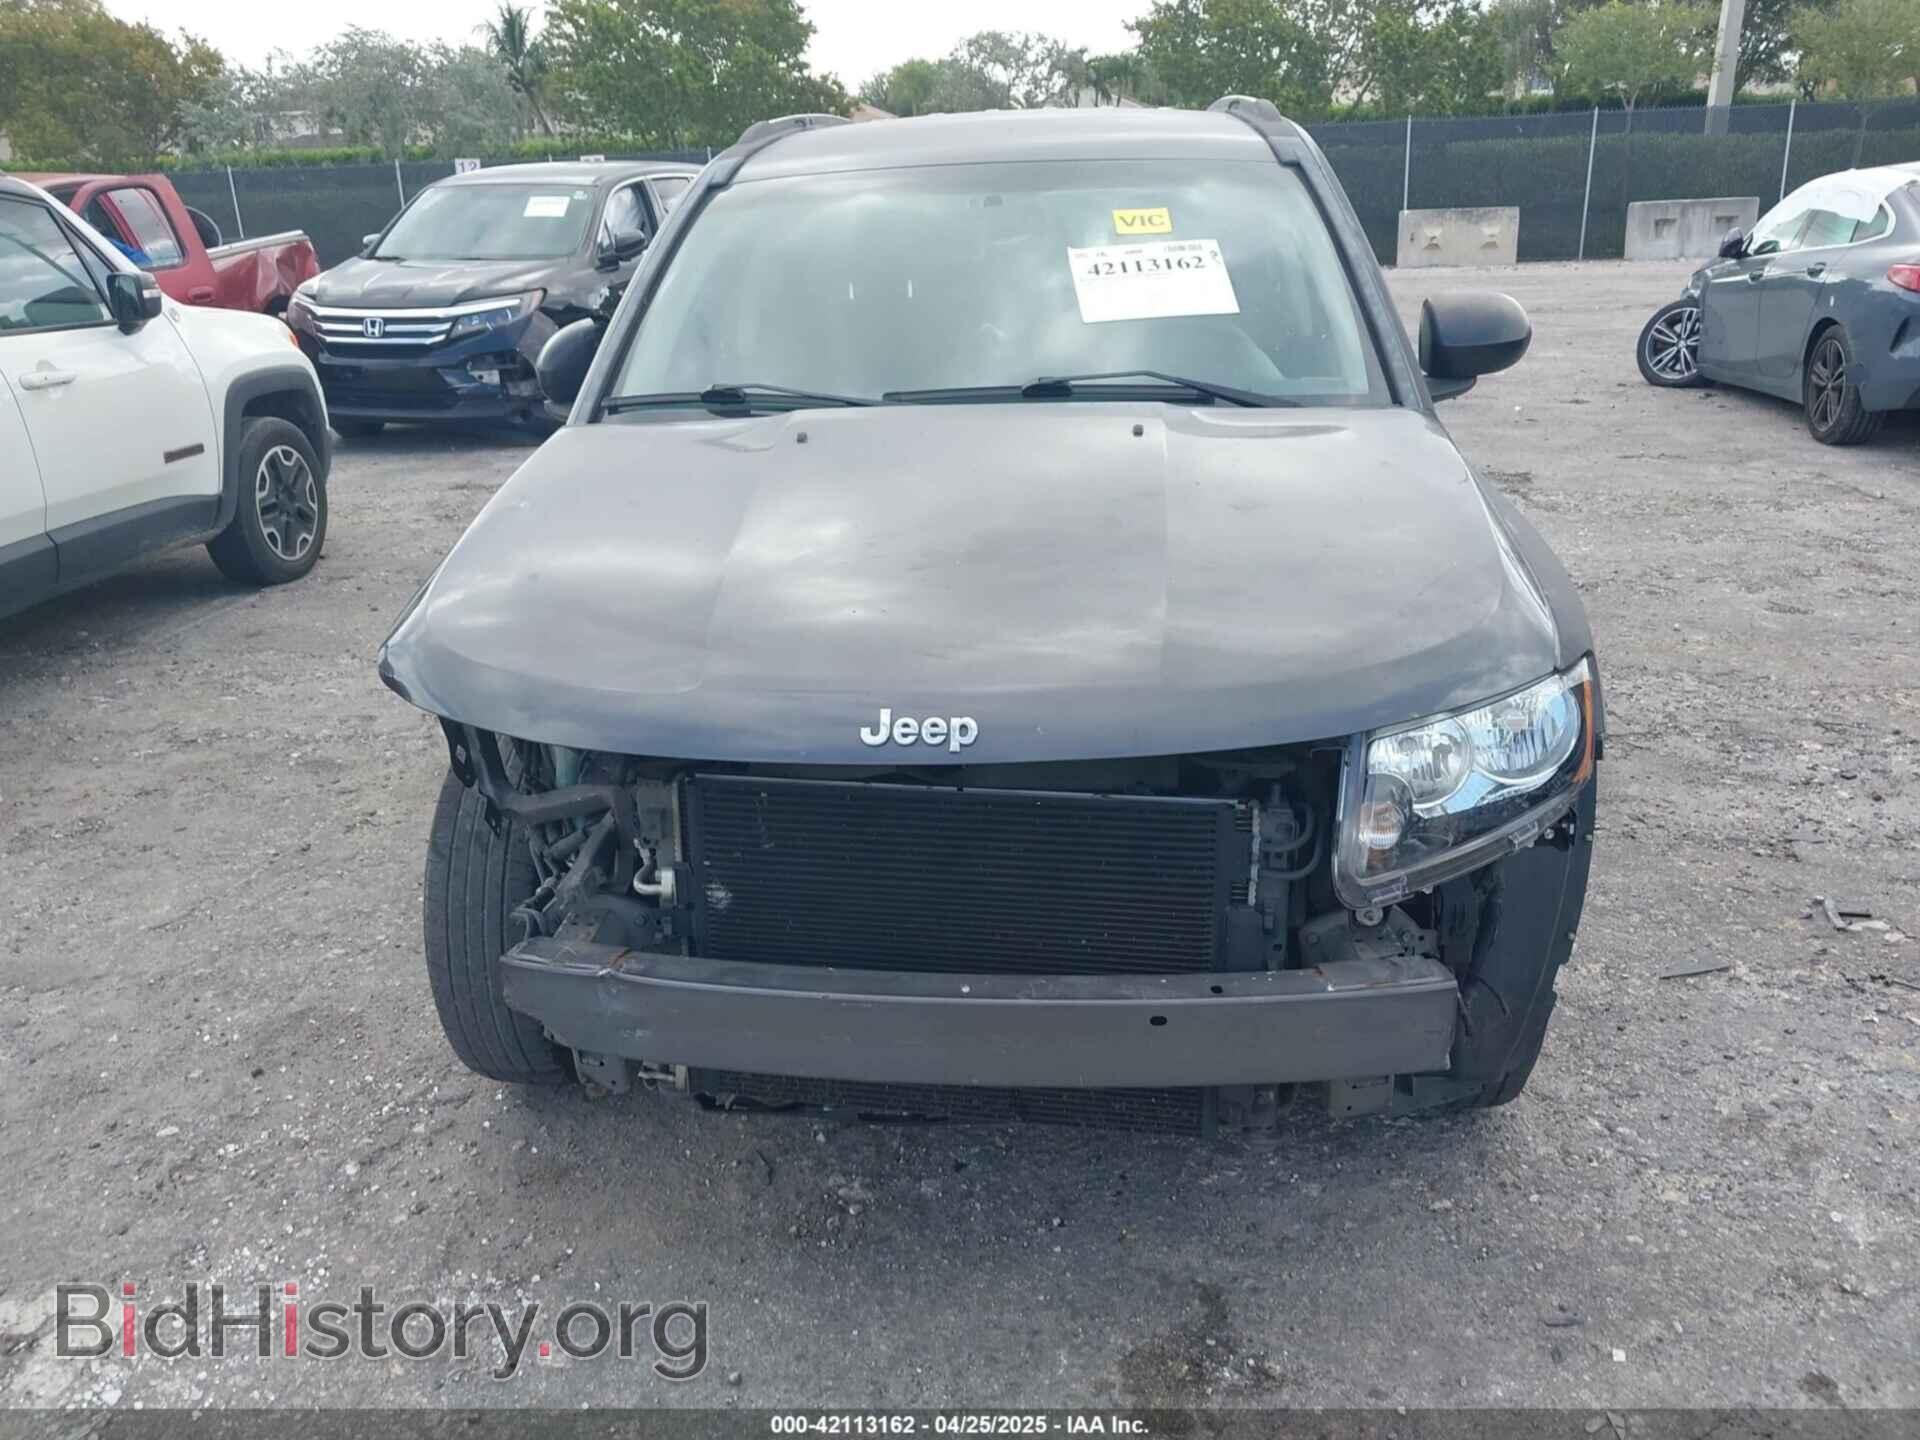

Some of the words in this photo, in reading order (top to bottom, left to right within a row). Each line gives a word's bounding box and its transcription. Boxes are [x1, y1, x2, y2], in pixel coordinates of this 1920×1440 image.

[1118, 214, 1165, 227] VIC
[1088, 256, 1205, 275] 42113162
[860, 708, 978, 752] Jeep
